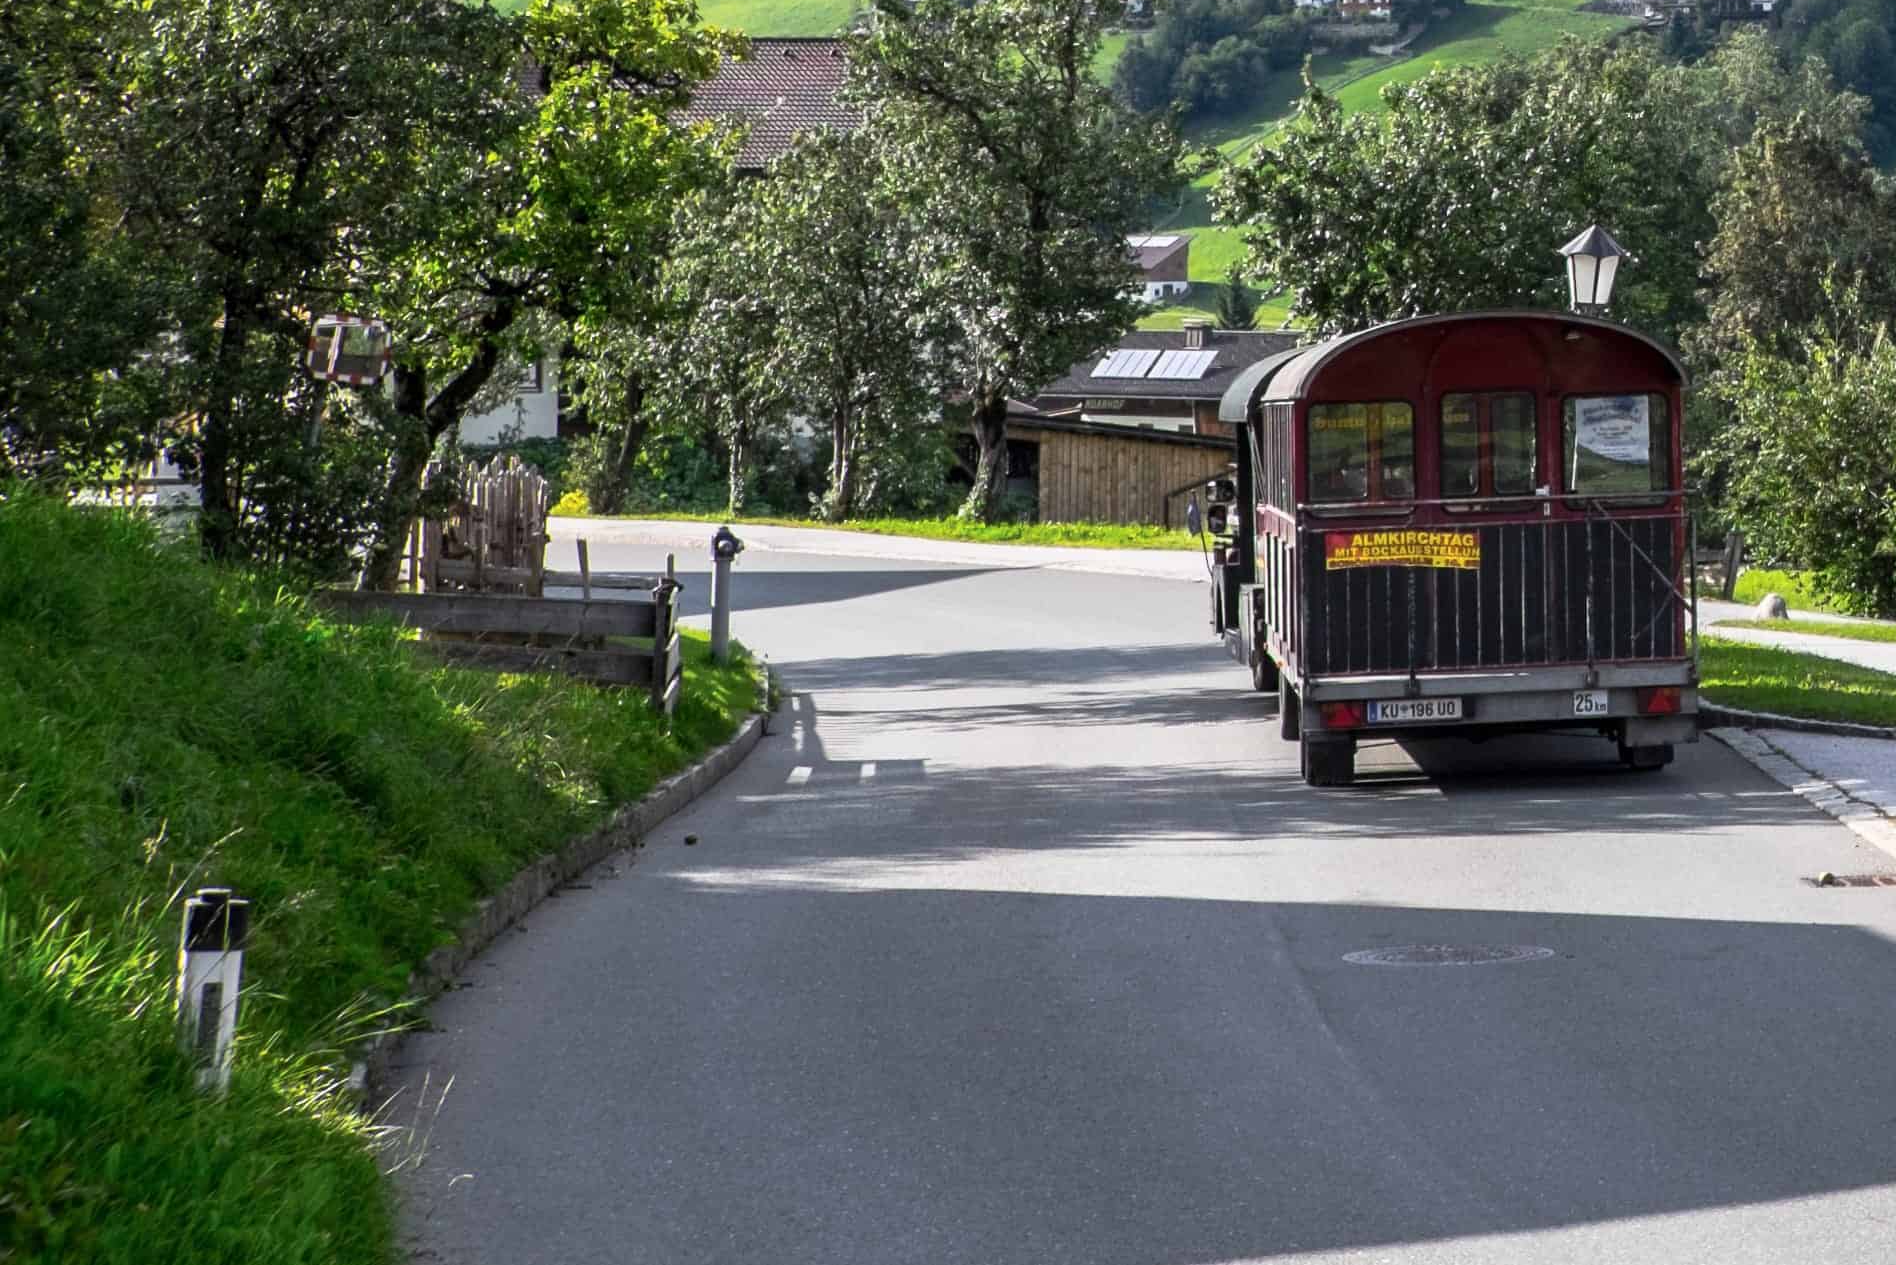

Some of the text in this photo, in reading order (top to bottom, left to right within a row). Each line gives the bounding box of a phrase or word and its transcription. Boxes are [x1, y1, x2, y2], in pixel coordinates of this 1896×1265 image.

[1352, 532, 1474, 546] ALMKIRCHTAG
[1335, 547, 1359, 558] MIT
[1381, 703, 1399, 718] KU
[1409, 702, 1434, 717] 196
[1576, 694, 1593, 712] 25
